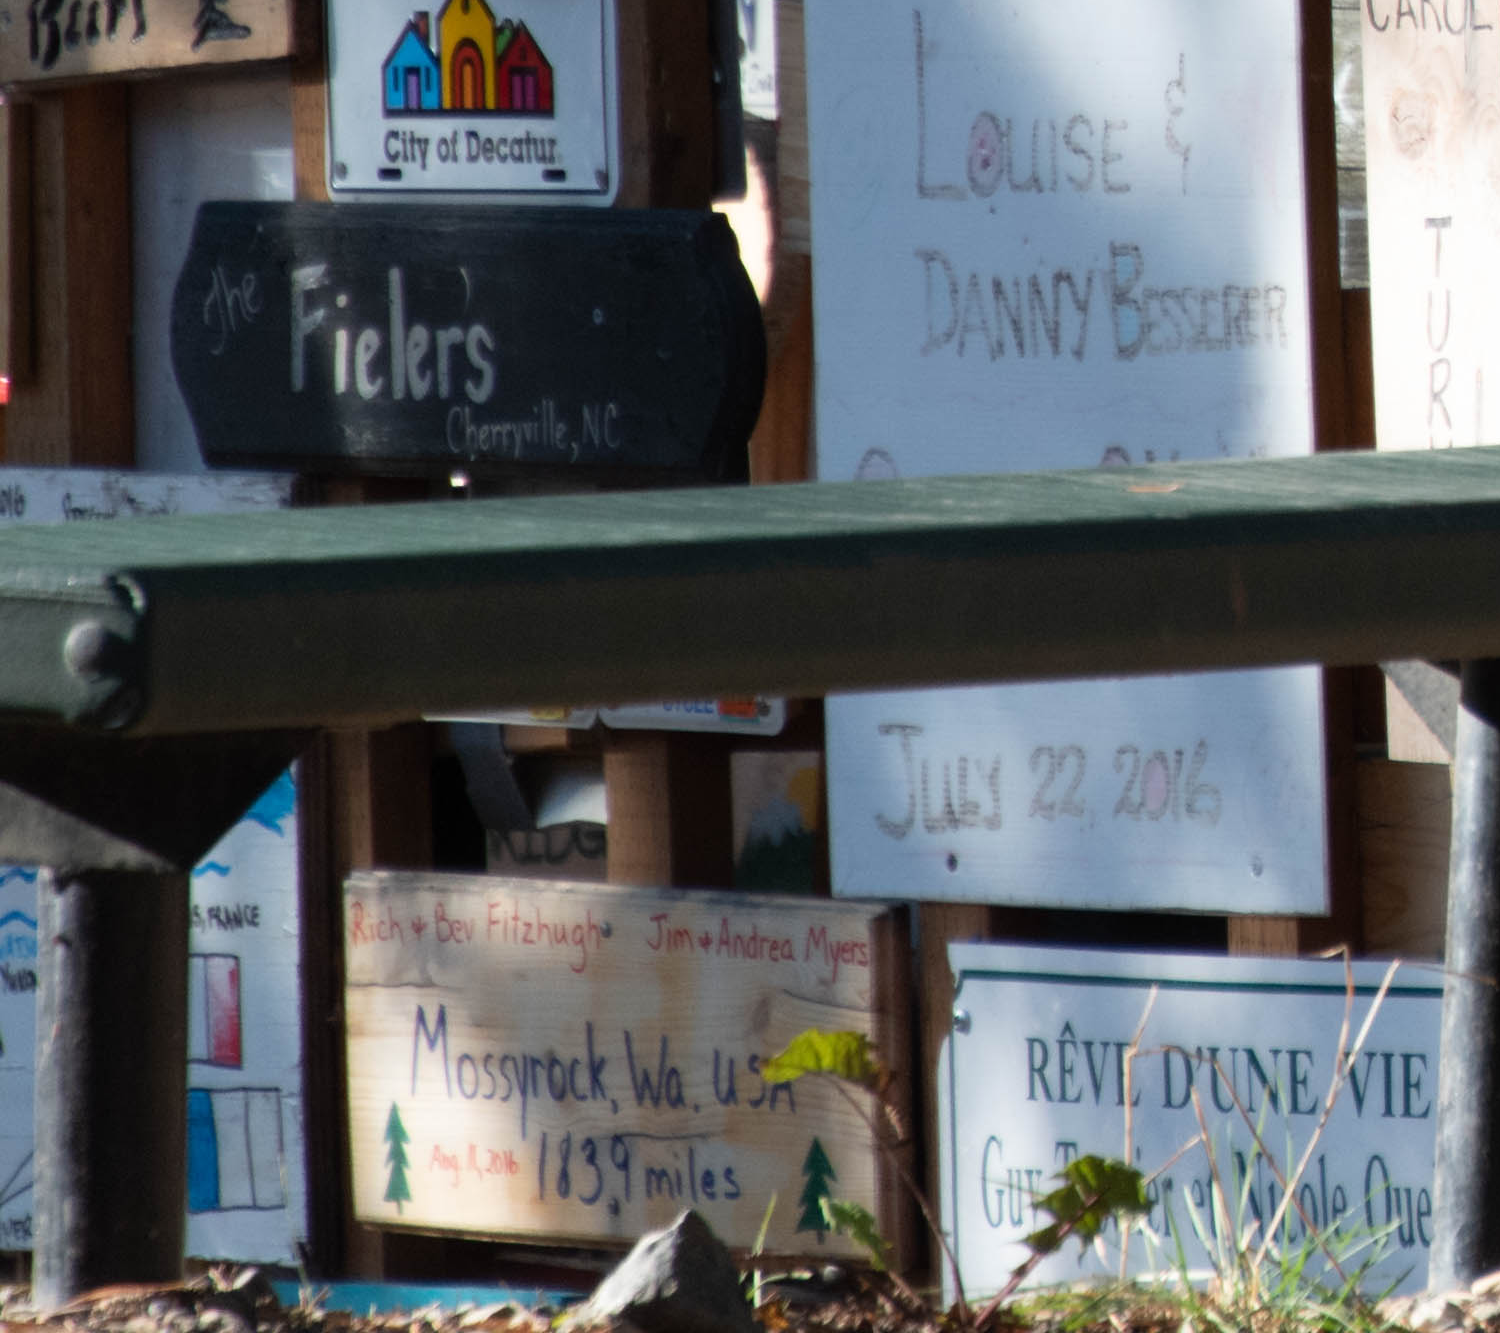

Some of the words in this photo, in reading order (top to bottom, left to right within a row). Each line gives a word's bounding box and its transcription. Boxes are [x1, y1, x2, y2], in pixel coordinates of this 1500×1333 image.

[382, 129, 431, 167] City
[437, 129, 460, 162] of
[464, 129, 558, 164] Decatur
[1112, 739, 1223, 829] 2016
[351, 900, 402, 946] Rich
[433, 902, 474, 945] Bev
[487, 899, 603, 974] Fitzhugh
[648, 911, 695, 950] Jim
[717, 916, 796, 964] Andrea
[803, 925, 871, 984] Myers
[411, 1003, 621, 1139] Mossyrock,
[622, 1028, 702, 1116] Wa.
[1025, 1017, 1147, 1111] RÊVE
[1161, 1043, 1318, 1120] D'UNE
[1347, 1051, 1433, 1121] VIE
[644, 1141, 743, 1201] miles
